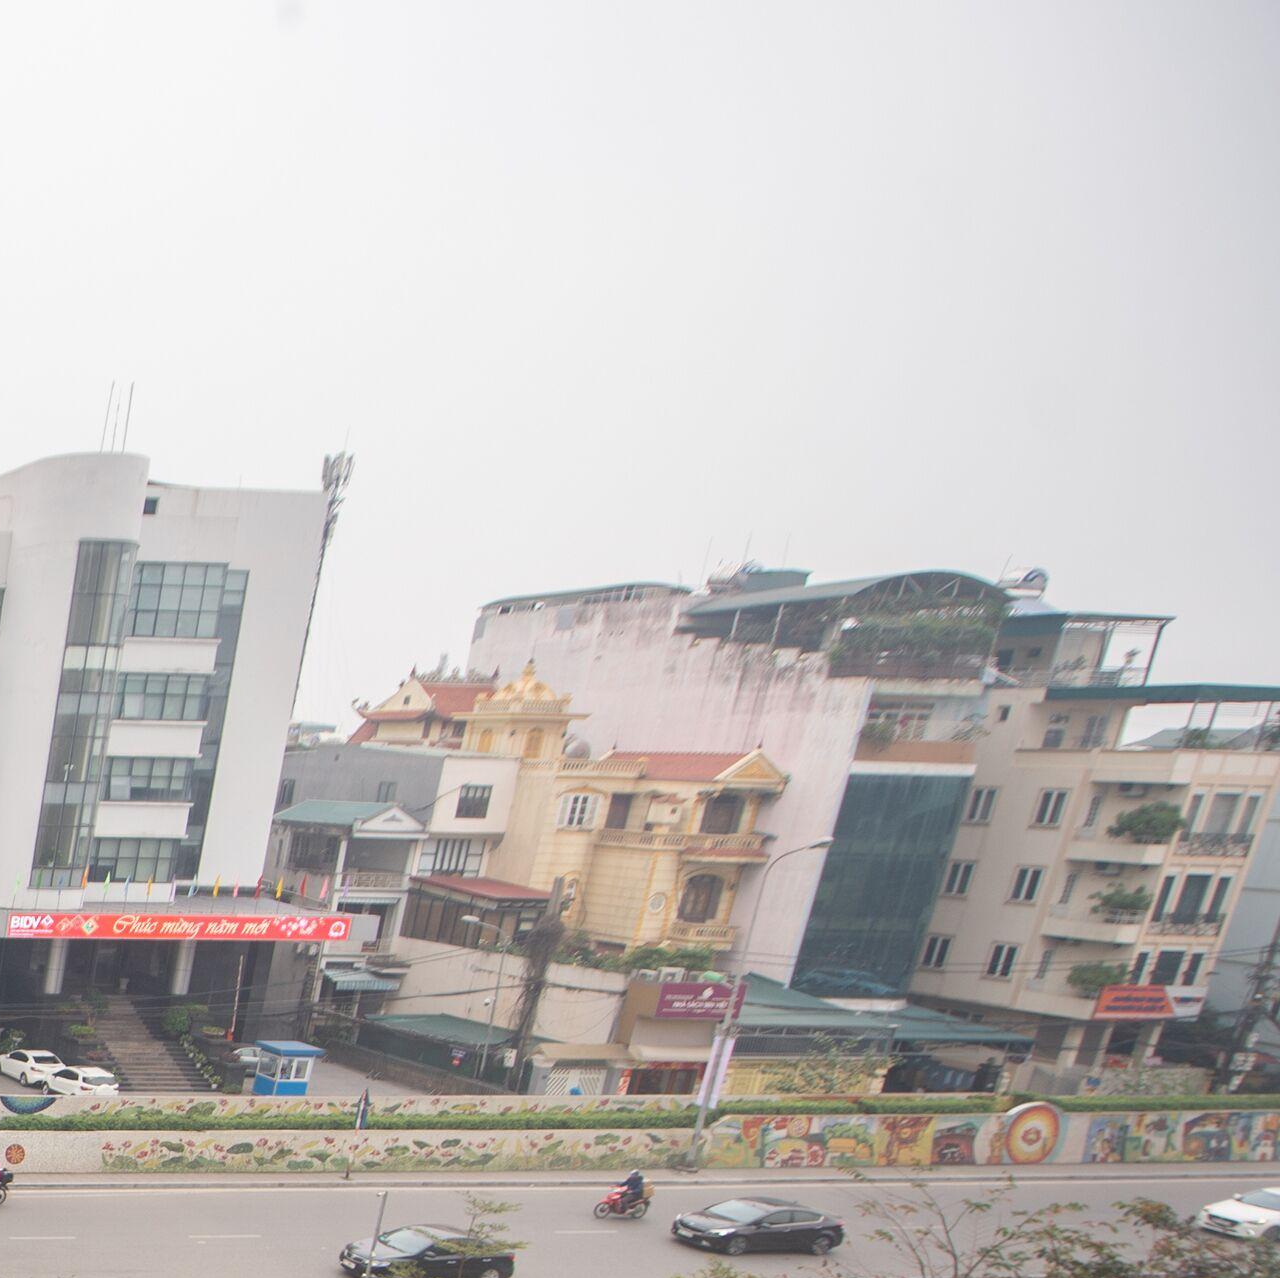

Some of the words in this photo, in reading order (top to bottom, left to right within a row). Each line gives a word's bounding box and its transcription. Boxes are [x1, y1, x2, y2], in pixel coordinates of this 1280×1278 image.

[10, 915, 41, 929] BIDV
[113, 914, 157, 934] Chúc
[160, 917, 200, 938] mừng
[206, 917, 238, 935] năm
[241, 919, 270, 935] mới
